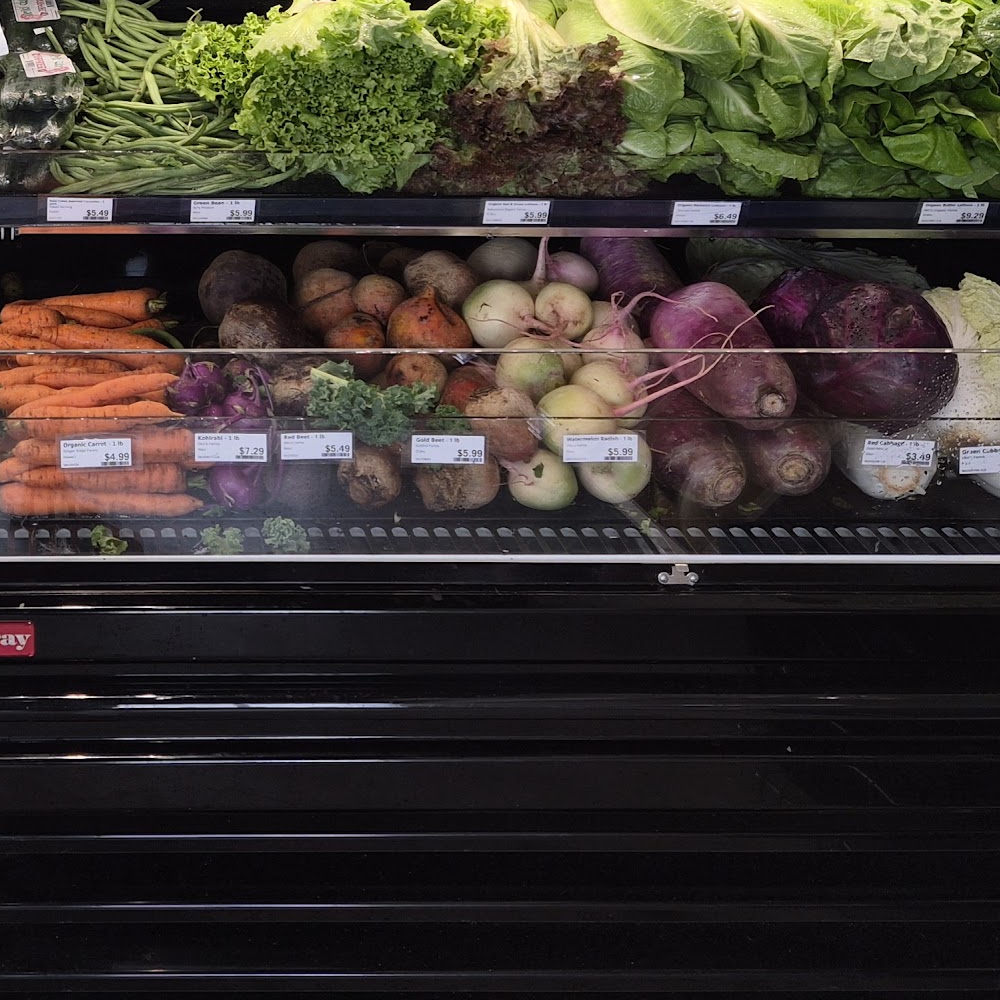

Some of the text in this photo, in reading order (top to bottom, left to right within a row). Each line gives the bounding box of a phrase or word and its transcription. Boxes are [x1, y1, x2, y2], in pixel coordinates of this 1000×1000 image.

[961, 212, 984, 220] $9.29
[239, 447, 265, 455] $7.29
[325, 445, 350, 453] $5.49
[608, 448, 634, 456] $5.99
[104, 452, 130, 461] $4.99
[457, 449, 483, 458] $5.99
[906, 452, 931, 461] $3.49
